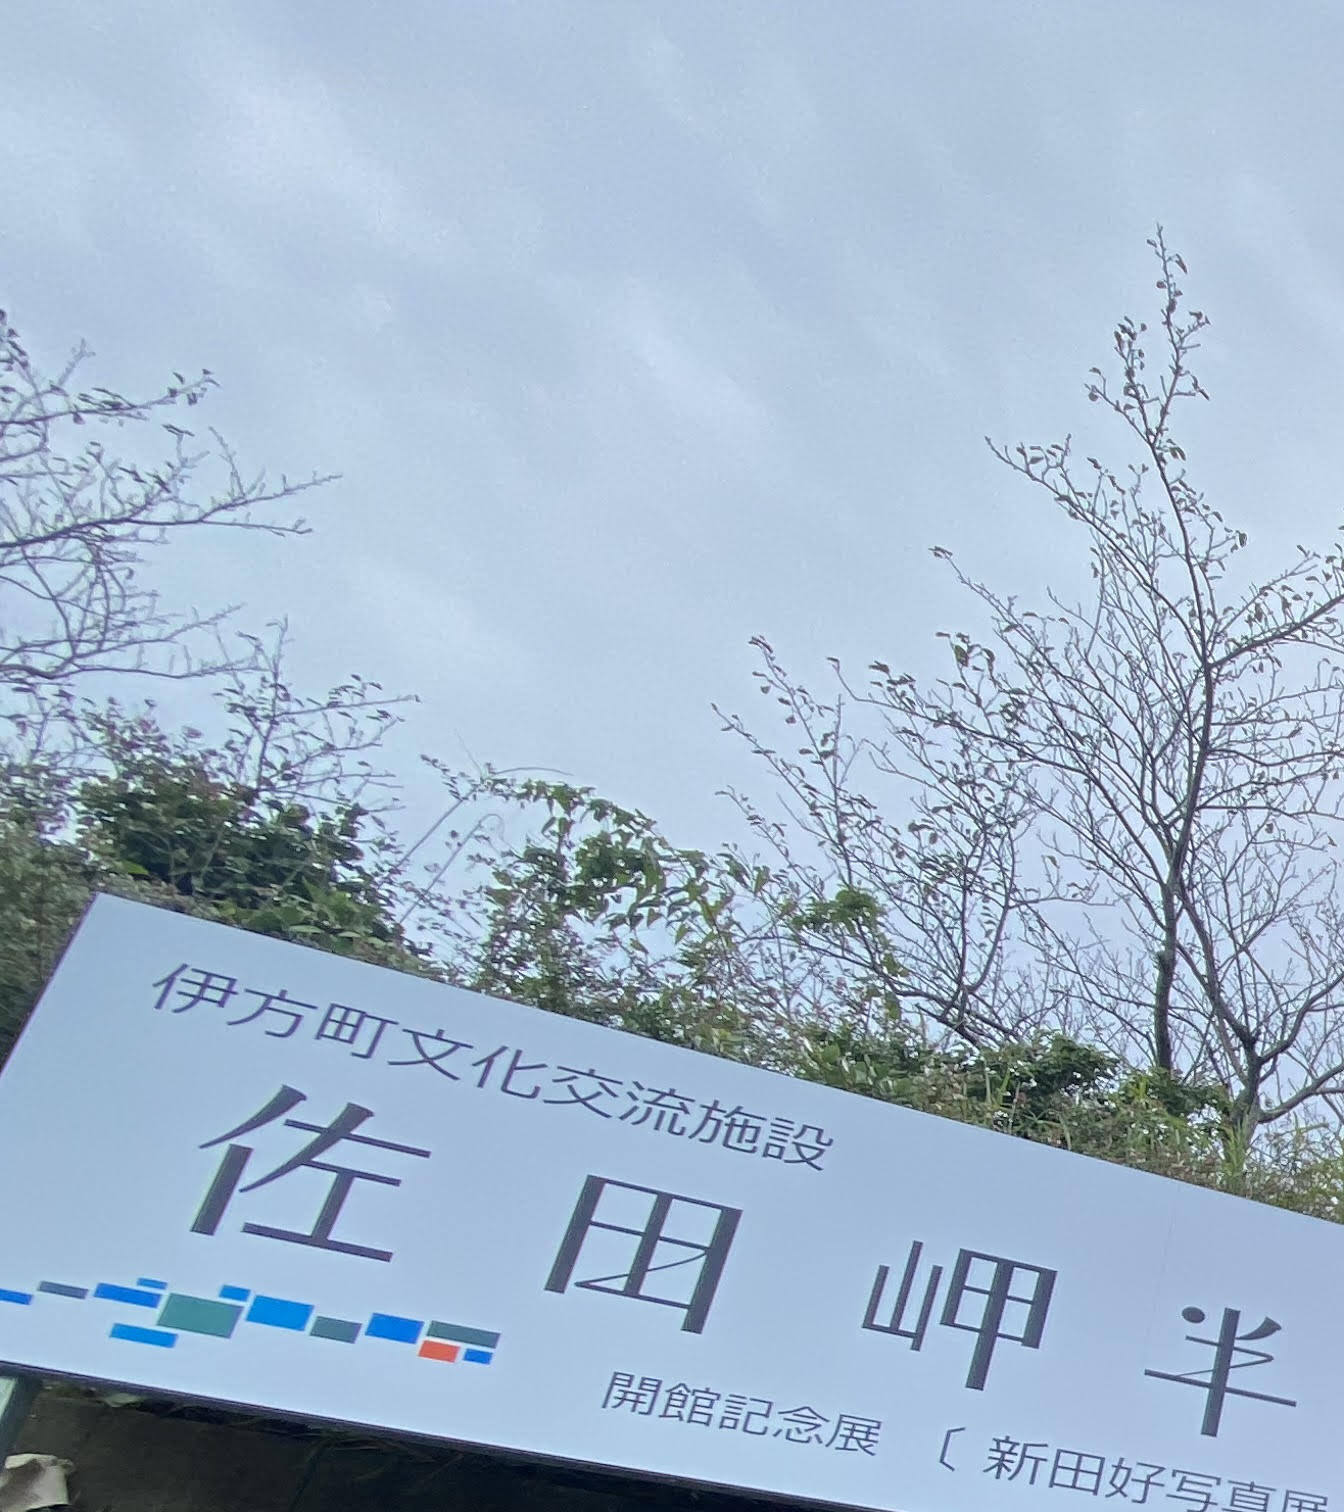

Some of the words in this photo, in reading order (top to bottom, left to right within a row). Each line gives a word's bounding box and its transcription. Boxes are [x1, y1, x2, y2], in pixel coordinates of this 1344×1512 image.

[152, 962, 835, 1172] 伊方町文化交流施設
[601, 1370, 883, 1457] 開館記念展
